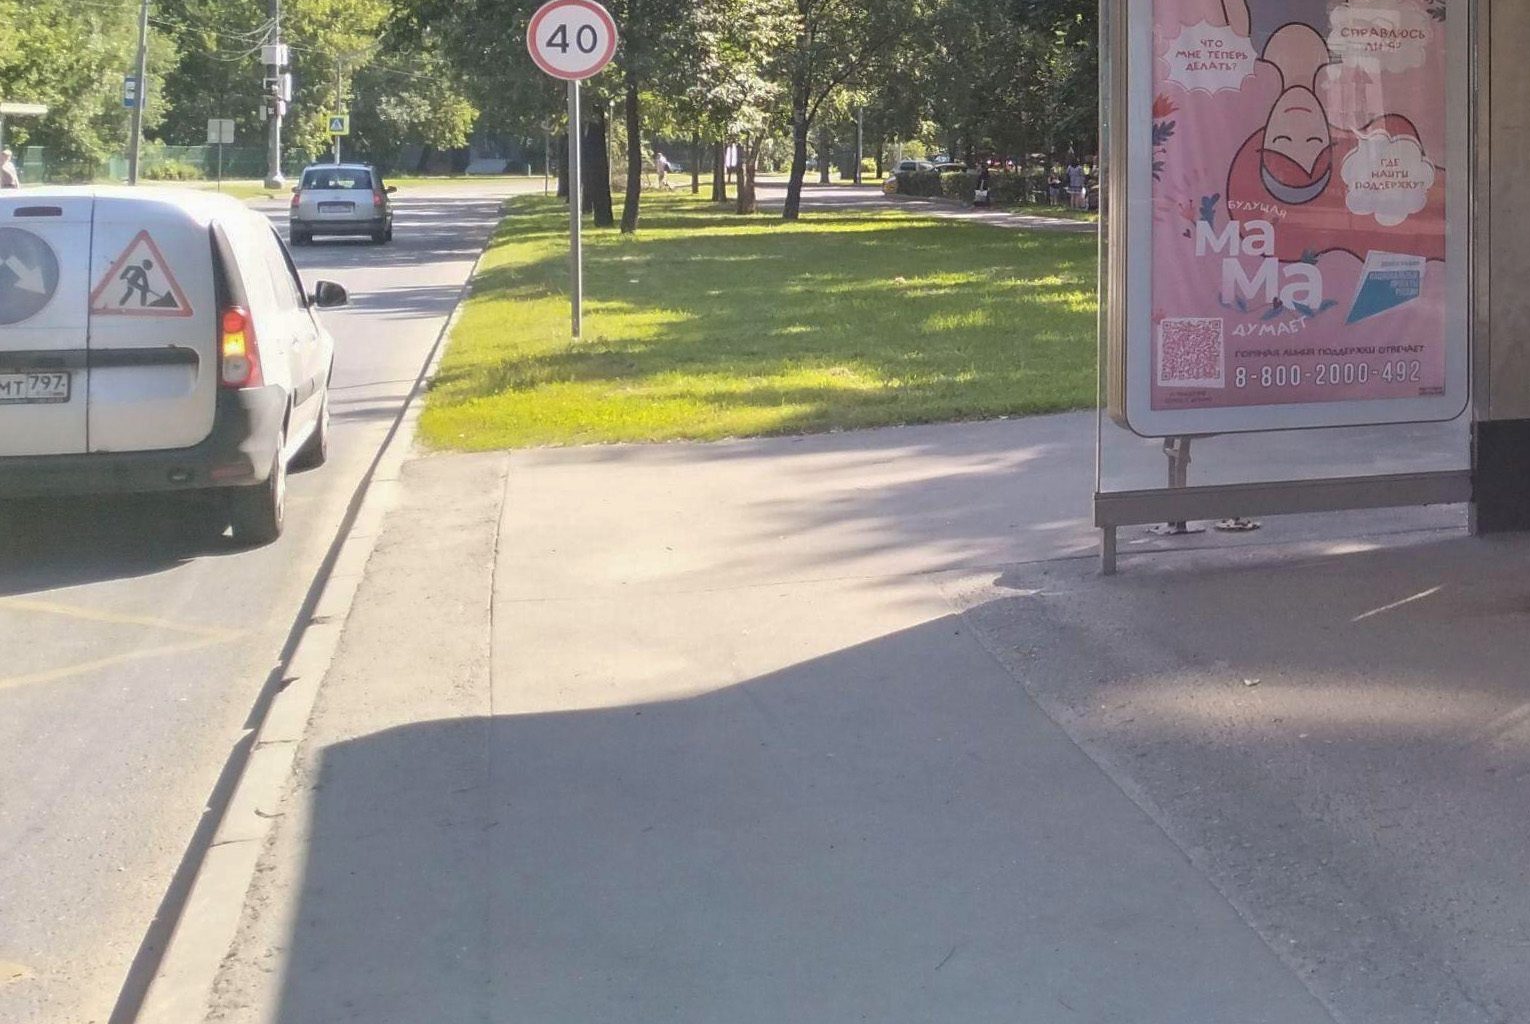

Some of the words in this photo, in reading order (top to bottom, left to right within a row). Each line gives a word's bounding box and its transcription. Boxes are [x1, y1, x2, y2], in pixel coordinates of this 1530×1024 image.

[545, 23, 598, 54] 40
[1200, 39, 1223, 48] ЧТО
[1175, 50, 1201, 59] МНЕ
[1207, 50, 1249, 60] ТЕПЕРЬ
[1185, 61, 1238, 72] ДЕЛАТЬ?
[1380, 158, 1400, 168] ГДЕ
[1228, 199, 1288, 219] БУДУЩАЯ
[1231, 315, 1307, 337] ДУМАЕТ
[1235, 360, 1421, 388] 8-800-2000-492
